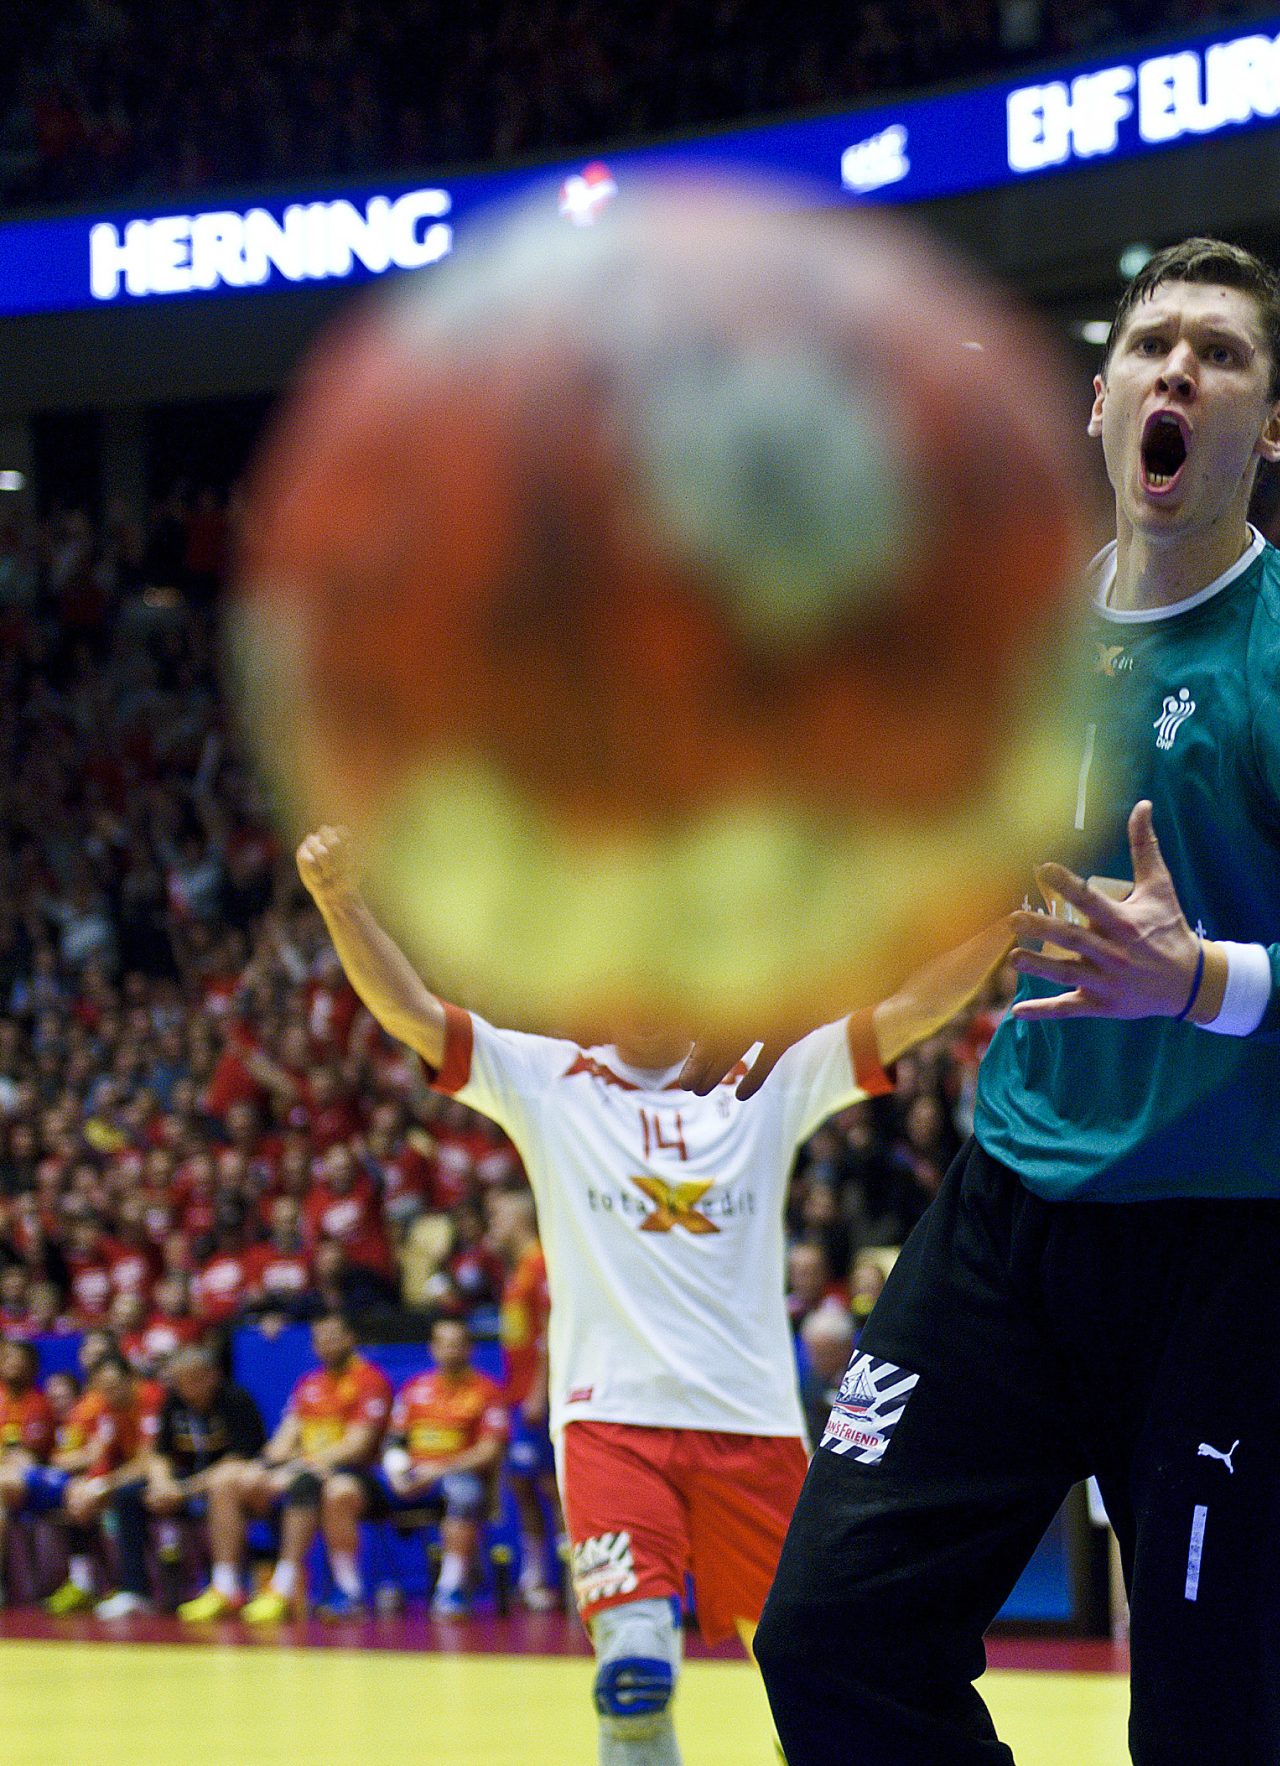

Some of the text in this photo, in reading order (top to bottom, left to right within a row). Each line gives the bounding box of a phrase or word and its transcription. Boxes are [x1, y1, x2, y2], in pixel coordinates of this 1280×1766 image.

[1007, 66, 1135, 172] EHF
[90, 189, 453, 299] HERNING
[639, 1108, 688, 1161] 14
[839, 1423, 879, 1447] FRIEND
